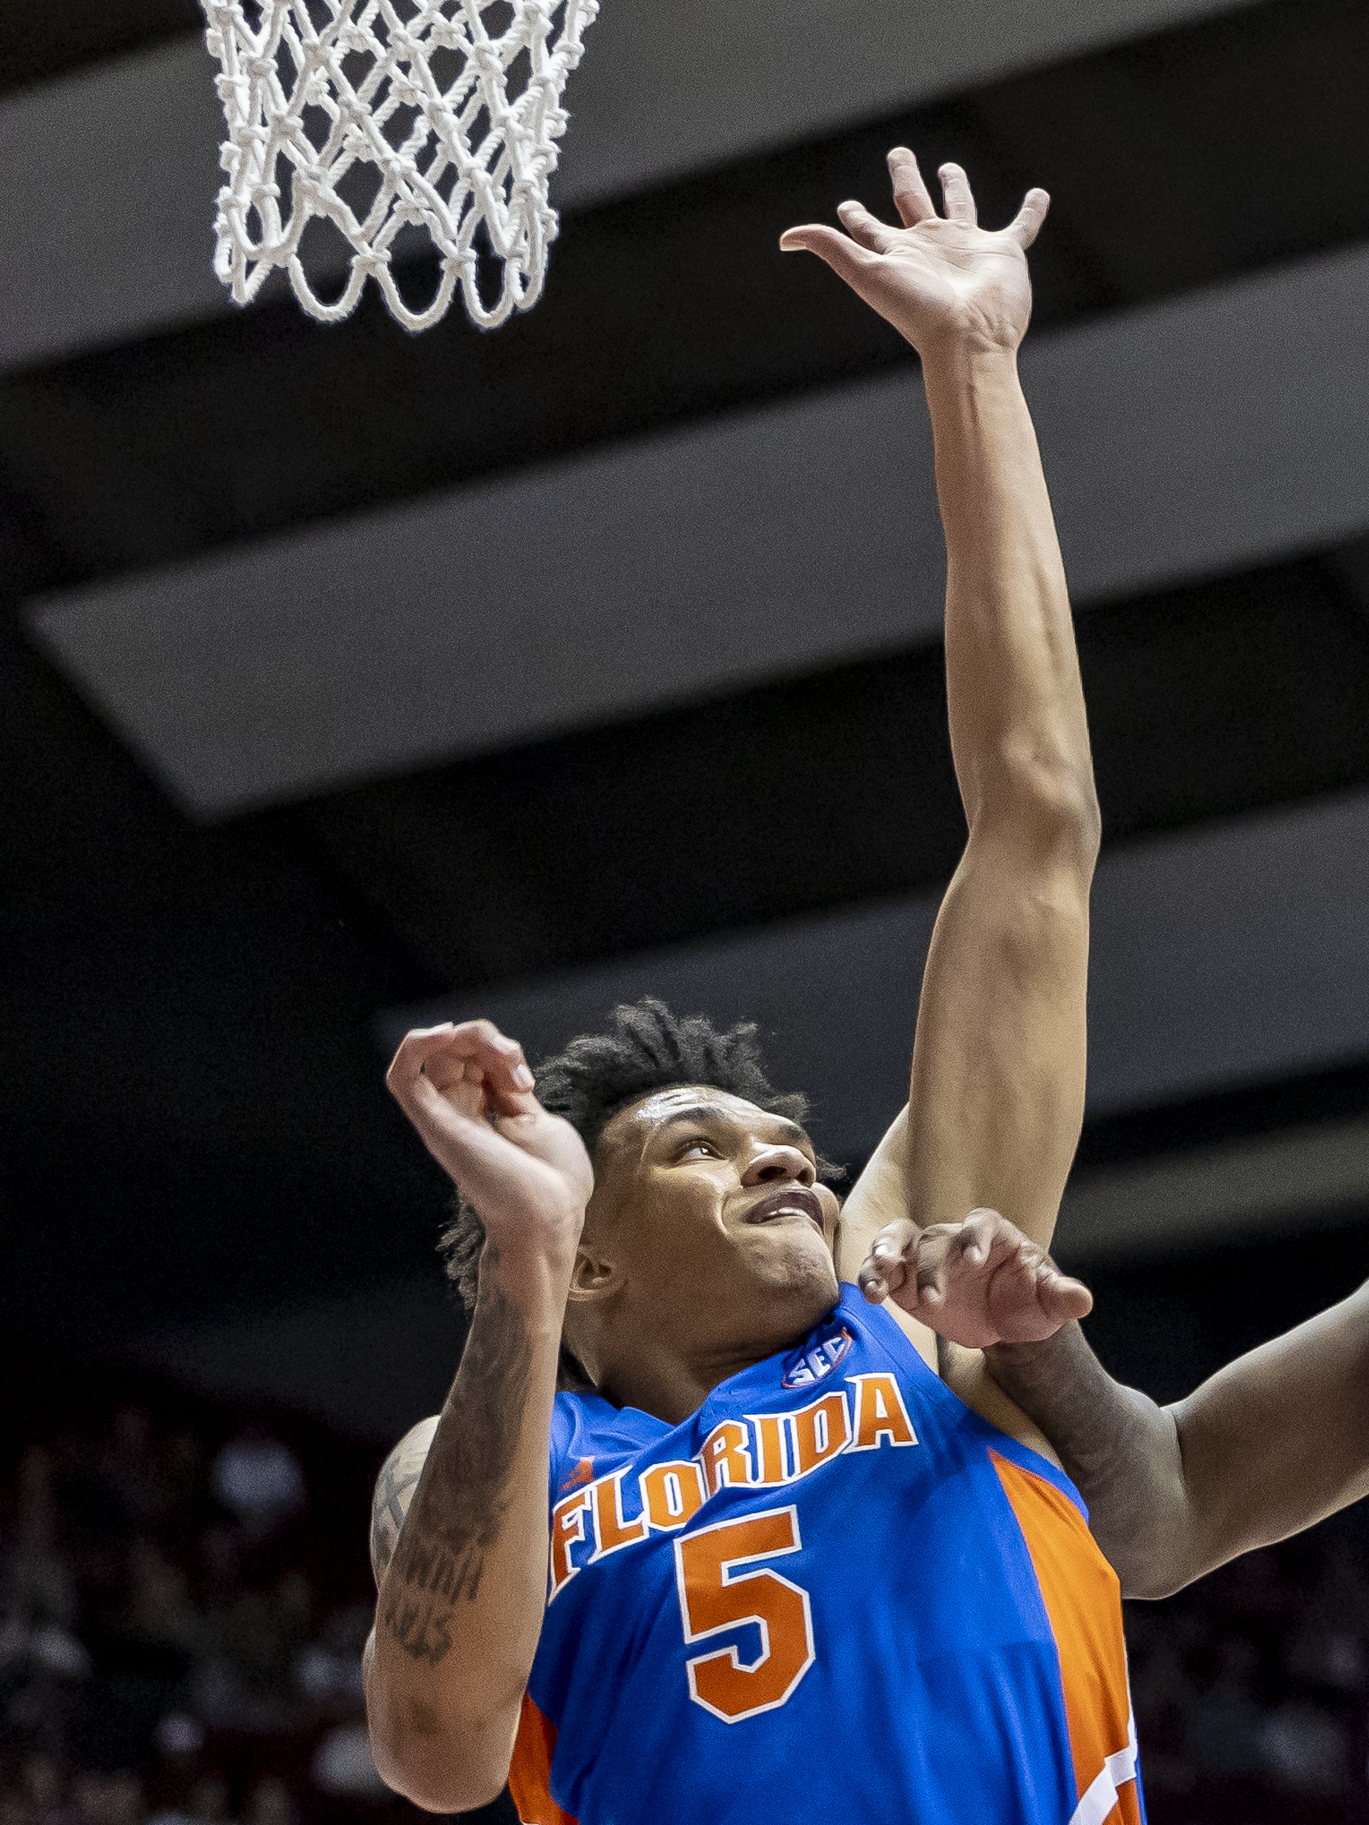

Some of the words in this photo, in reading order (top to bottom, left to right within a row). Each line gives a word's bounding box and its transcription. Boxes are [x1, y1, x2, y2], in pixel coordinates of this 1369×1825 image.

[788, 1337, 845, 1384] SEC
[548, 1372, 919, 1605] FLORIDA
[673, 1504, 816, 1724] 5
